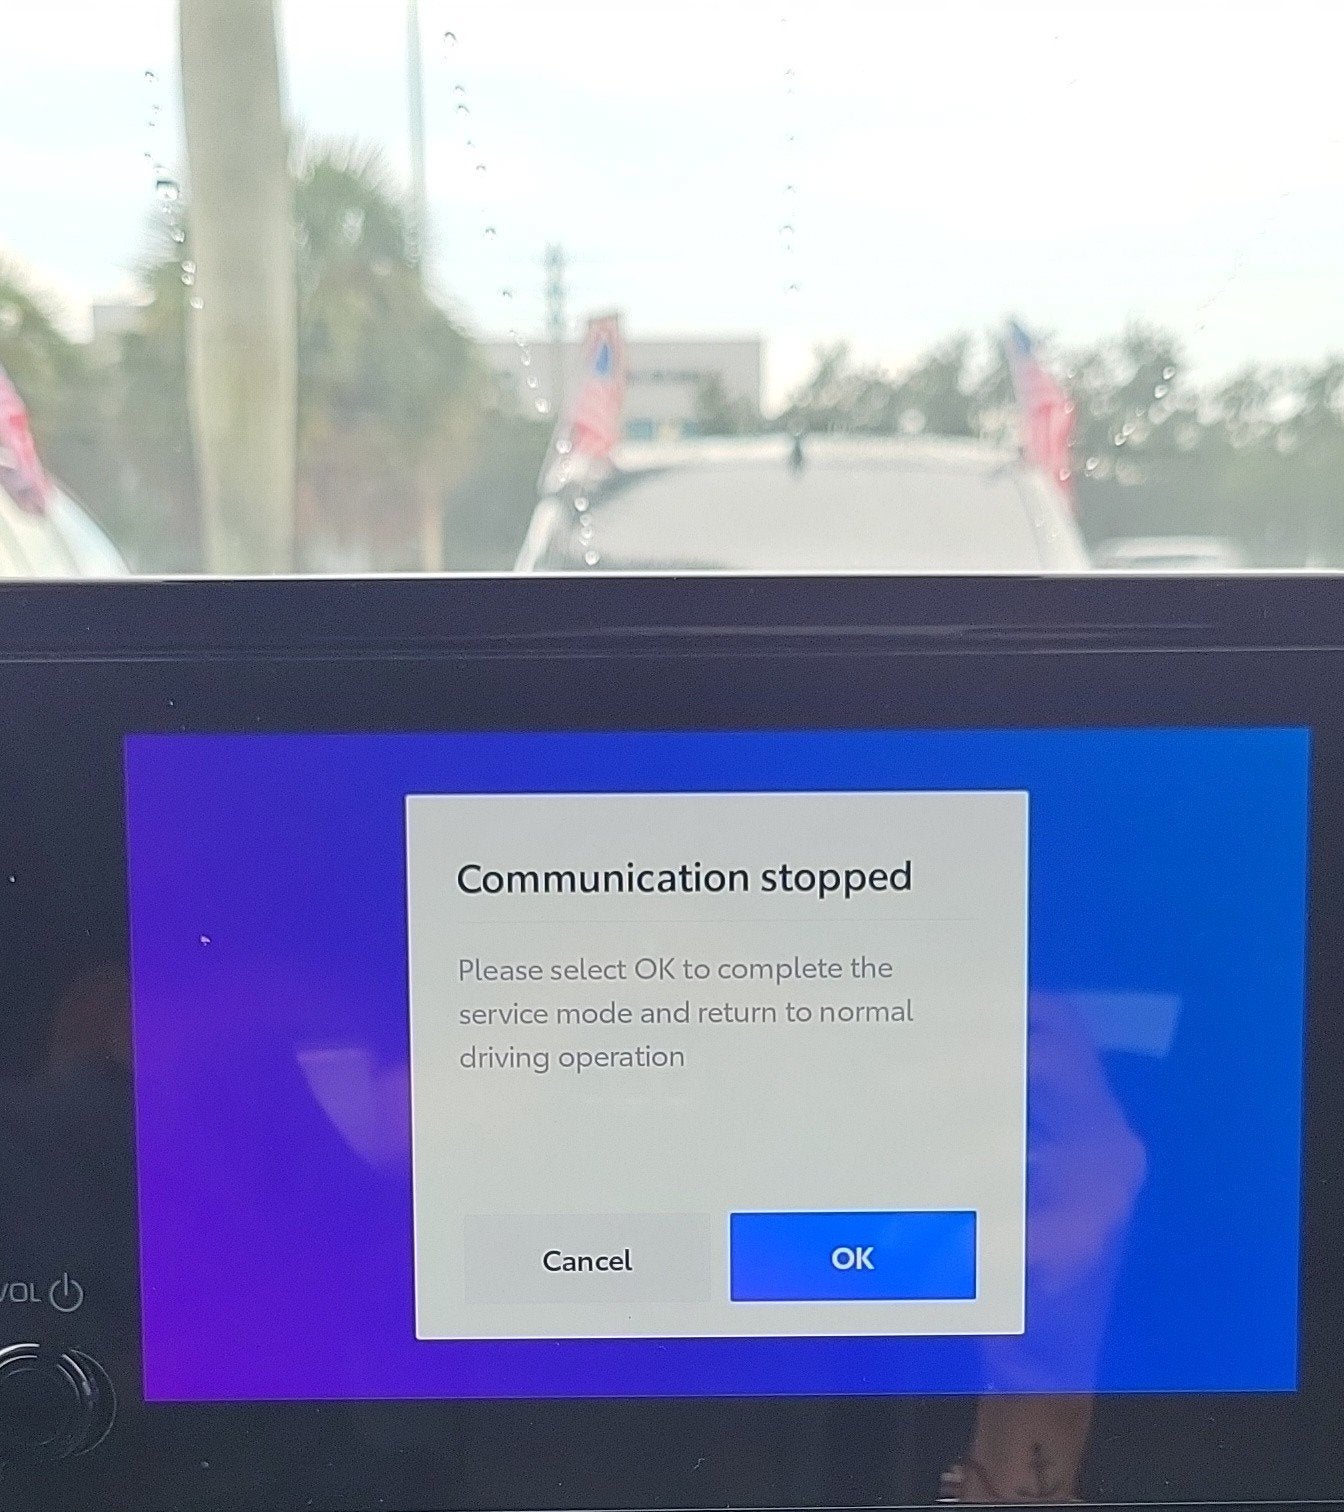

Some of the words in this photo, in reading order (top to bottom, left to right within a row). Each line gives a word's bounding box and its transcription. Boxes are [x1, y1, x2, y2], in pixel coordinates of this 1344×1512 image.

[457, 861, 750, 895] Communication
[760, 860, 913, 899] stopped
[459, 958, 543, 981] Please
[551, 957, 626, 981] select
[634, 957, 676, 981] OK
[683, 960, 710, 980] to
[718, 956, 843, 986] complete
[850, 955, 893, 979] the
[459, 1002, 548, 1026] service
[556, 1000, 633, 1025] mode
[640, 1000, 690, 1024] and
[698, 1002, 777, 1024] return
[785, 1002, 812, 1023] to
[819, 998, 914, 1023] normal
[459, 1045, 550, 1075] driving
[558, 1046, 685, 1074] operation
[543, 1248, 633, 1272] Cancel
[831, 1246, 875, 1271] OK
